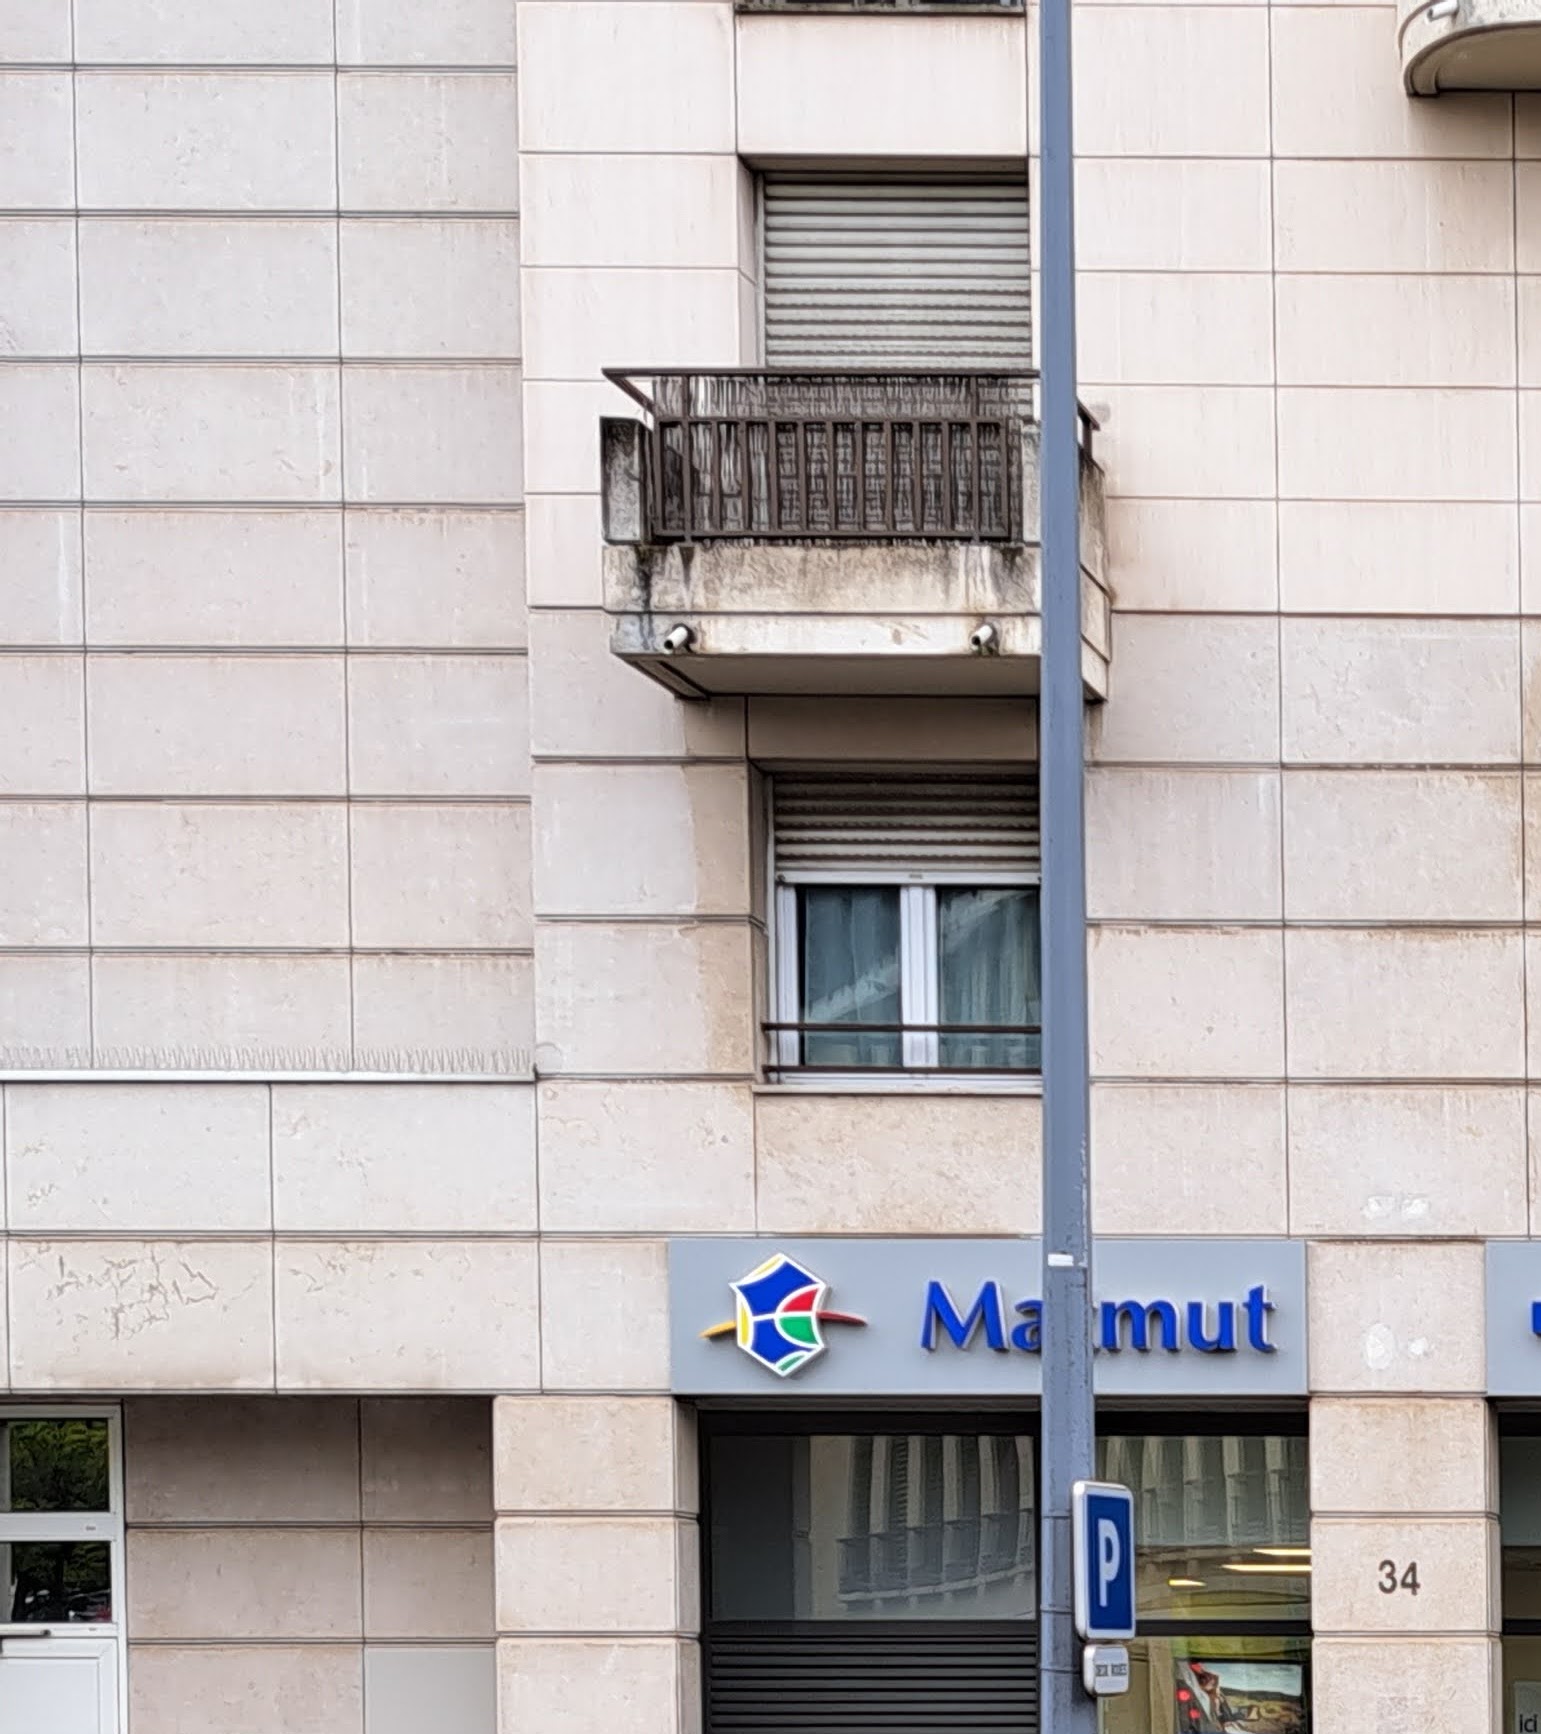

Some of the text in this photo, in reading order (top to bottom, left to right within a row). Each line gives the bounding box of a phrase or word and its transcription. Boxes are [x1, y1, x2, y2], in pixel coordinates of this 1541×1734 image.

[920, 1280, 1277, 1352] Mamut
[1098, 1517, 1121, 1608] P
[1378, 1559, 1421, 1596] 34
